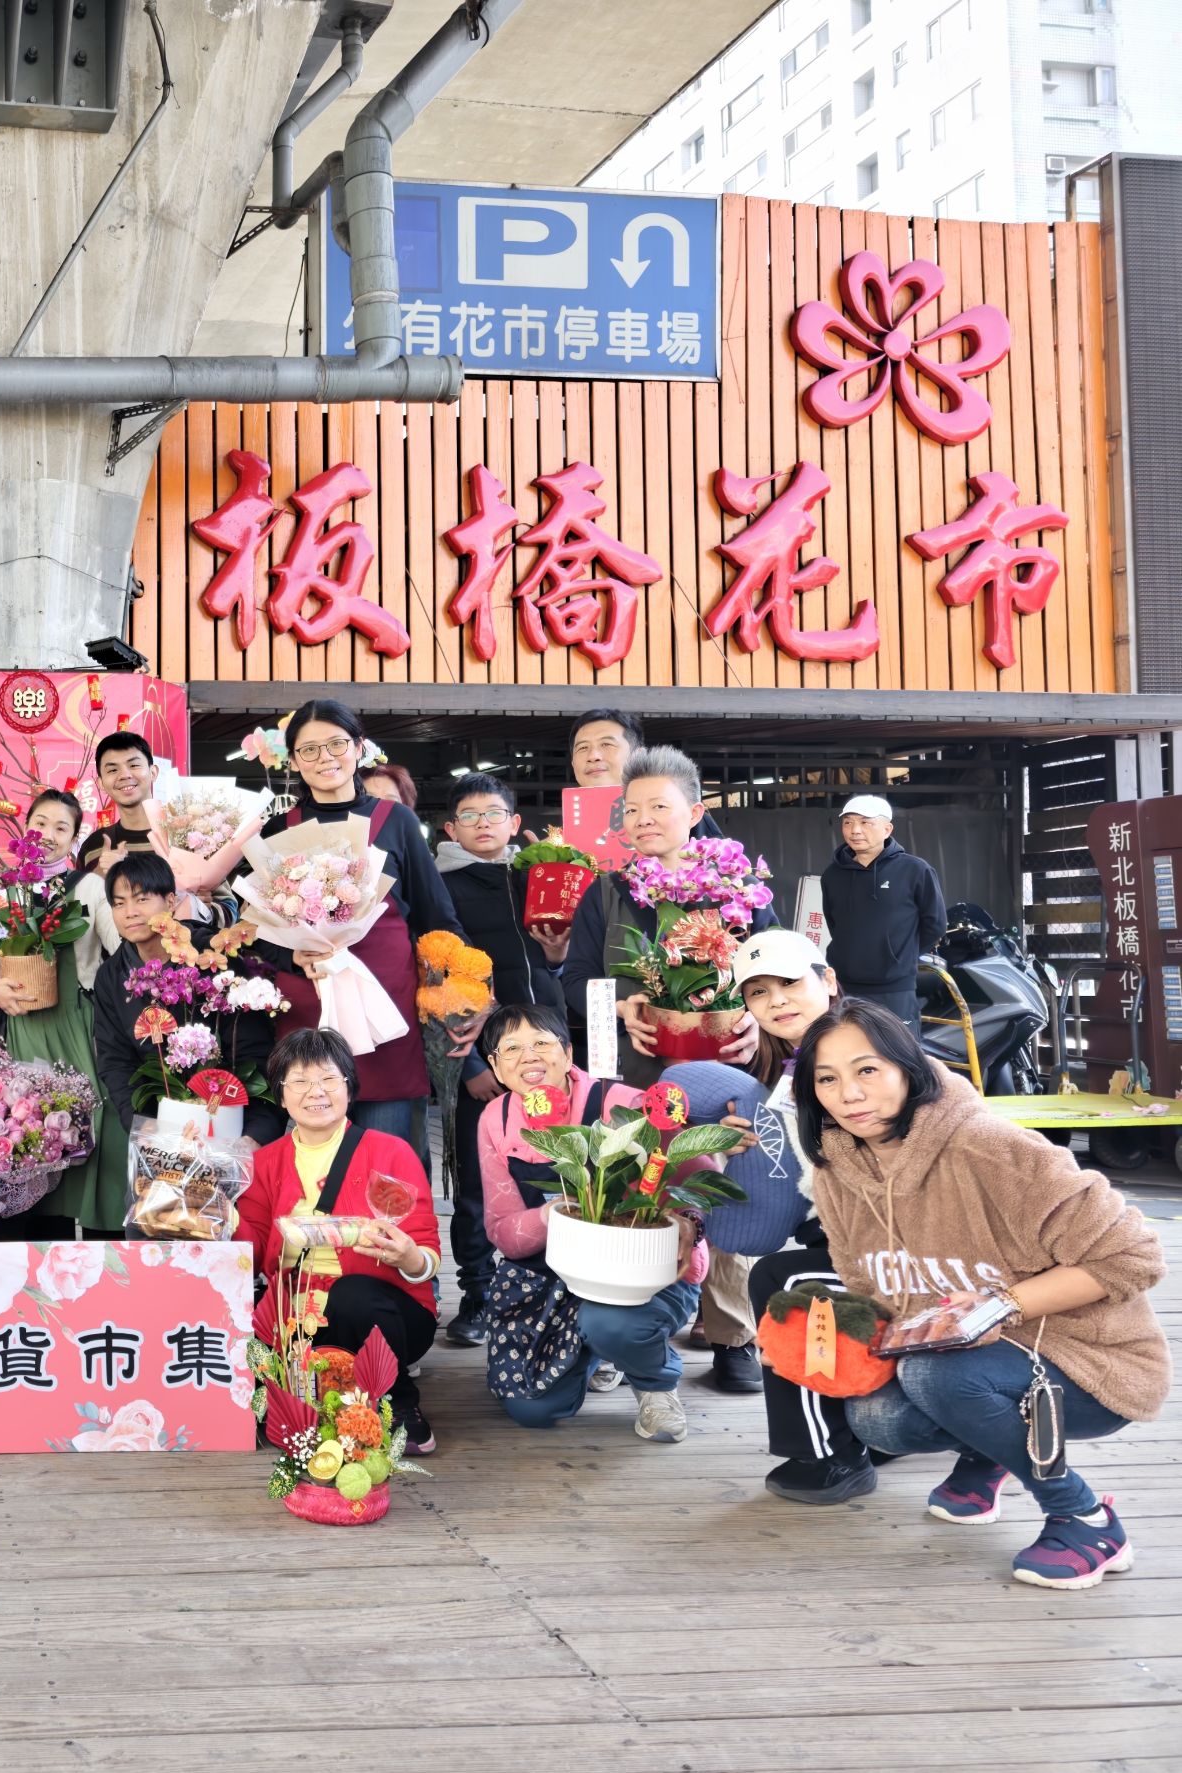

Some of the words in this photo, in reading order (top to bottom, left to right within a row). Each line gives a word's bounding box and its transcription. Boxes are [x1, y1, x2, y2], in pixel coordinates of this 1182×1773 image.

[474, 204, 578, 281] P
[191, 448, 1070, 670] 板橋花市
